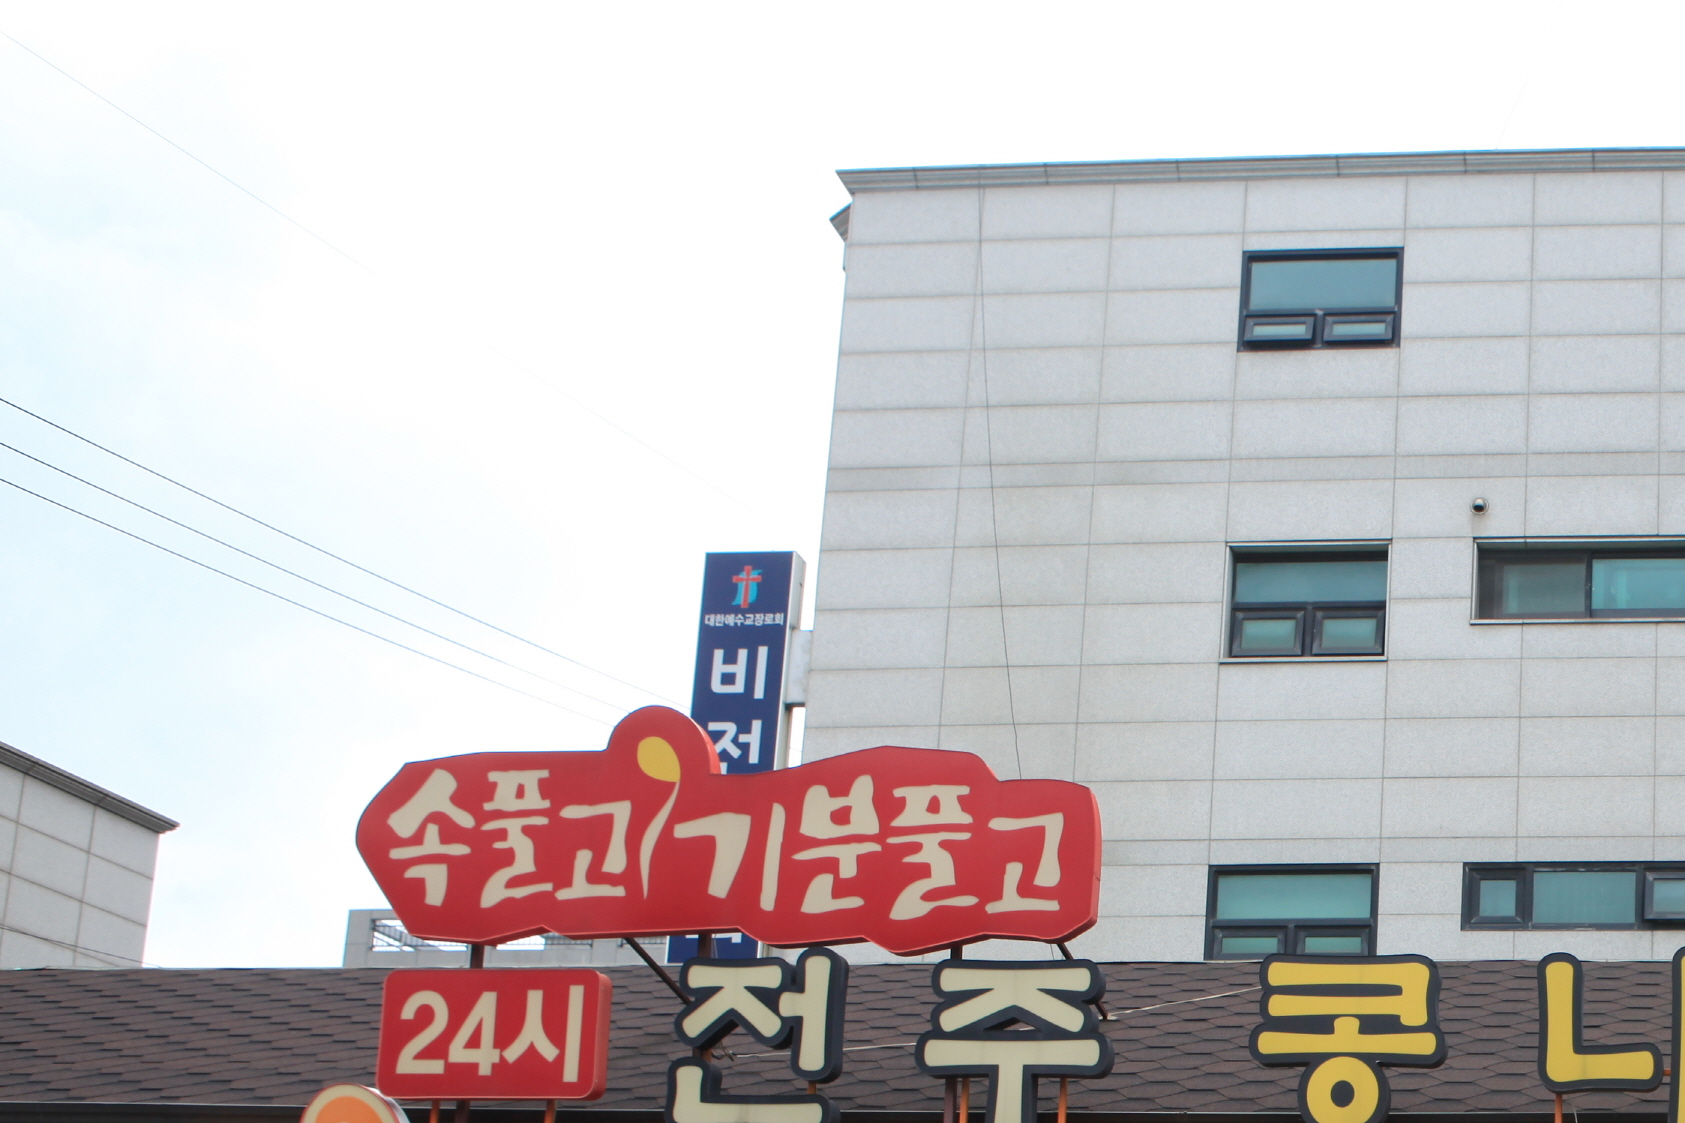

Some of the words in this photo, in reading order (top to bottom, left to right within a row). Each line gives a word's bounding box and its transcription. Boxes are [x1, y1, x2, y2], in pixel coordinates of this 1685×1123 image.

[704, 613, 784, 626] 대한예수교장로회
[388, 769, 631, 908] 속풀고
[674, 775, 1064, 921] 기분풀고
[396, 984, 585, 1083] 24시
